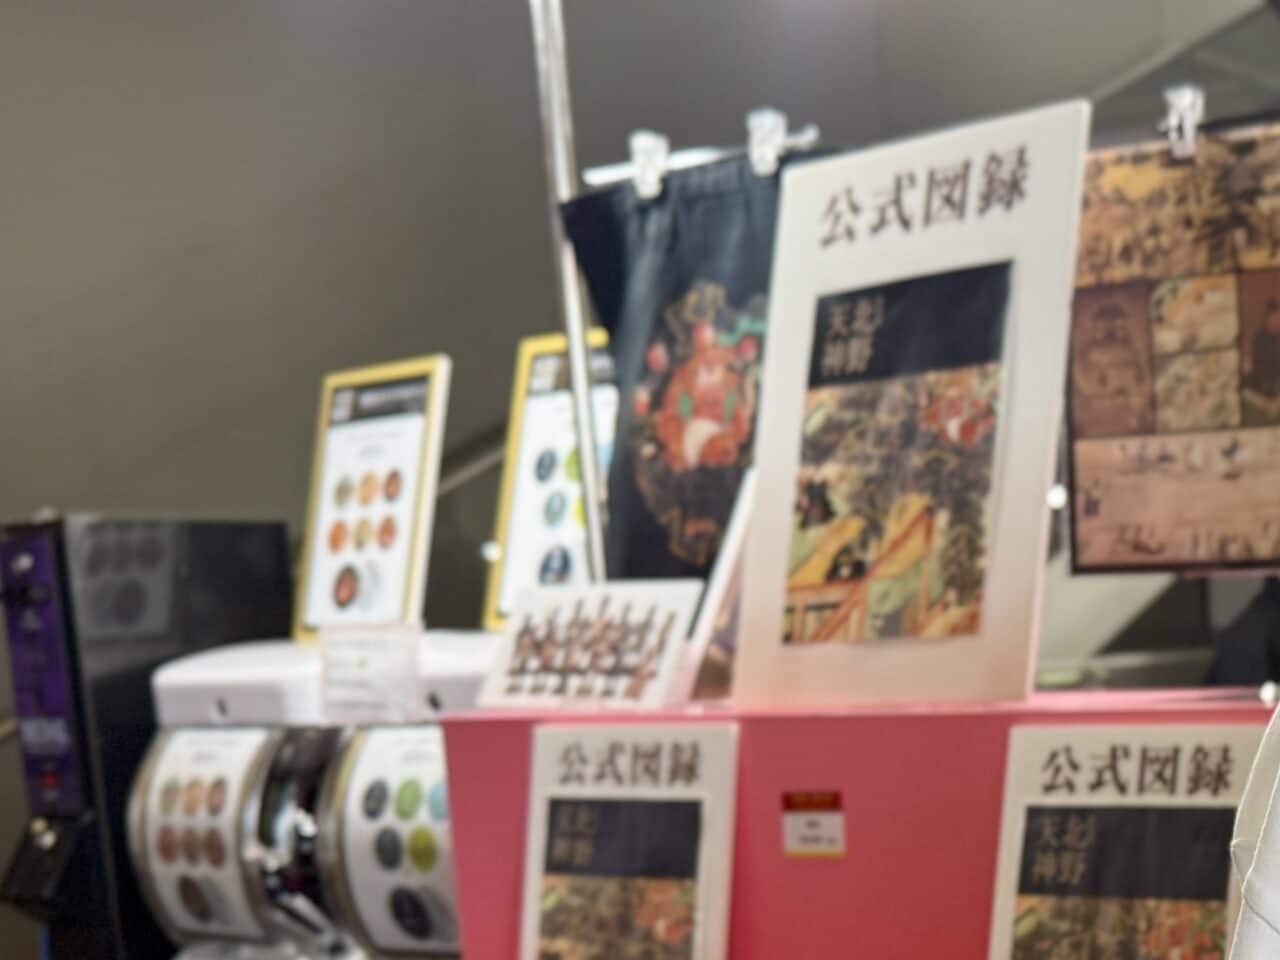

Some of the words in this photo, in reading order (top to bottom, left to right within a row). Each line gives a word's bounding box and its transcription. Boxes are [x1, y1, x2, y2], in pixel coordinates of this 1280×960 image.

[819, 146, 1029, 249] 公式図録
[558, 741, 701, 787] 公式図録
[1041, 744, 1234, 797] 公式図録
